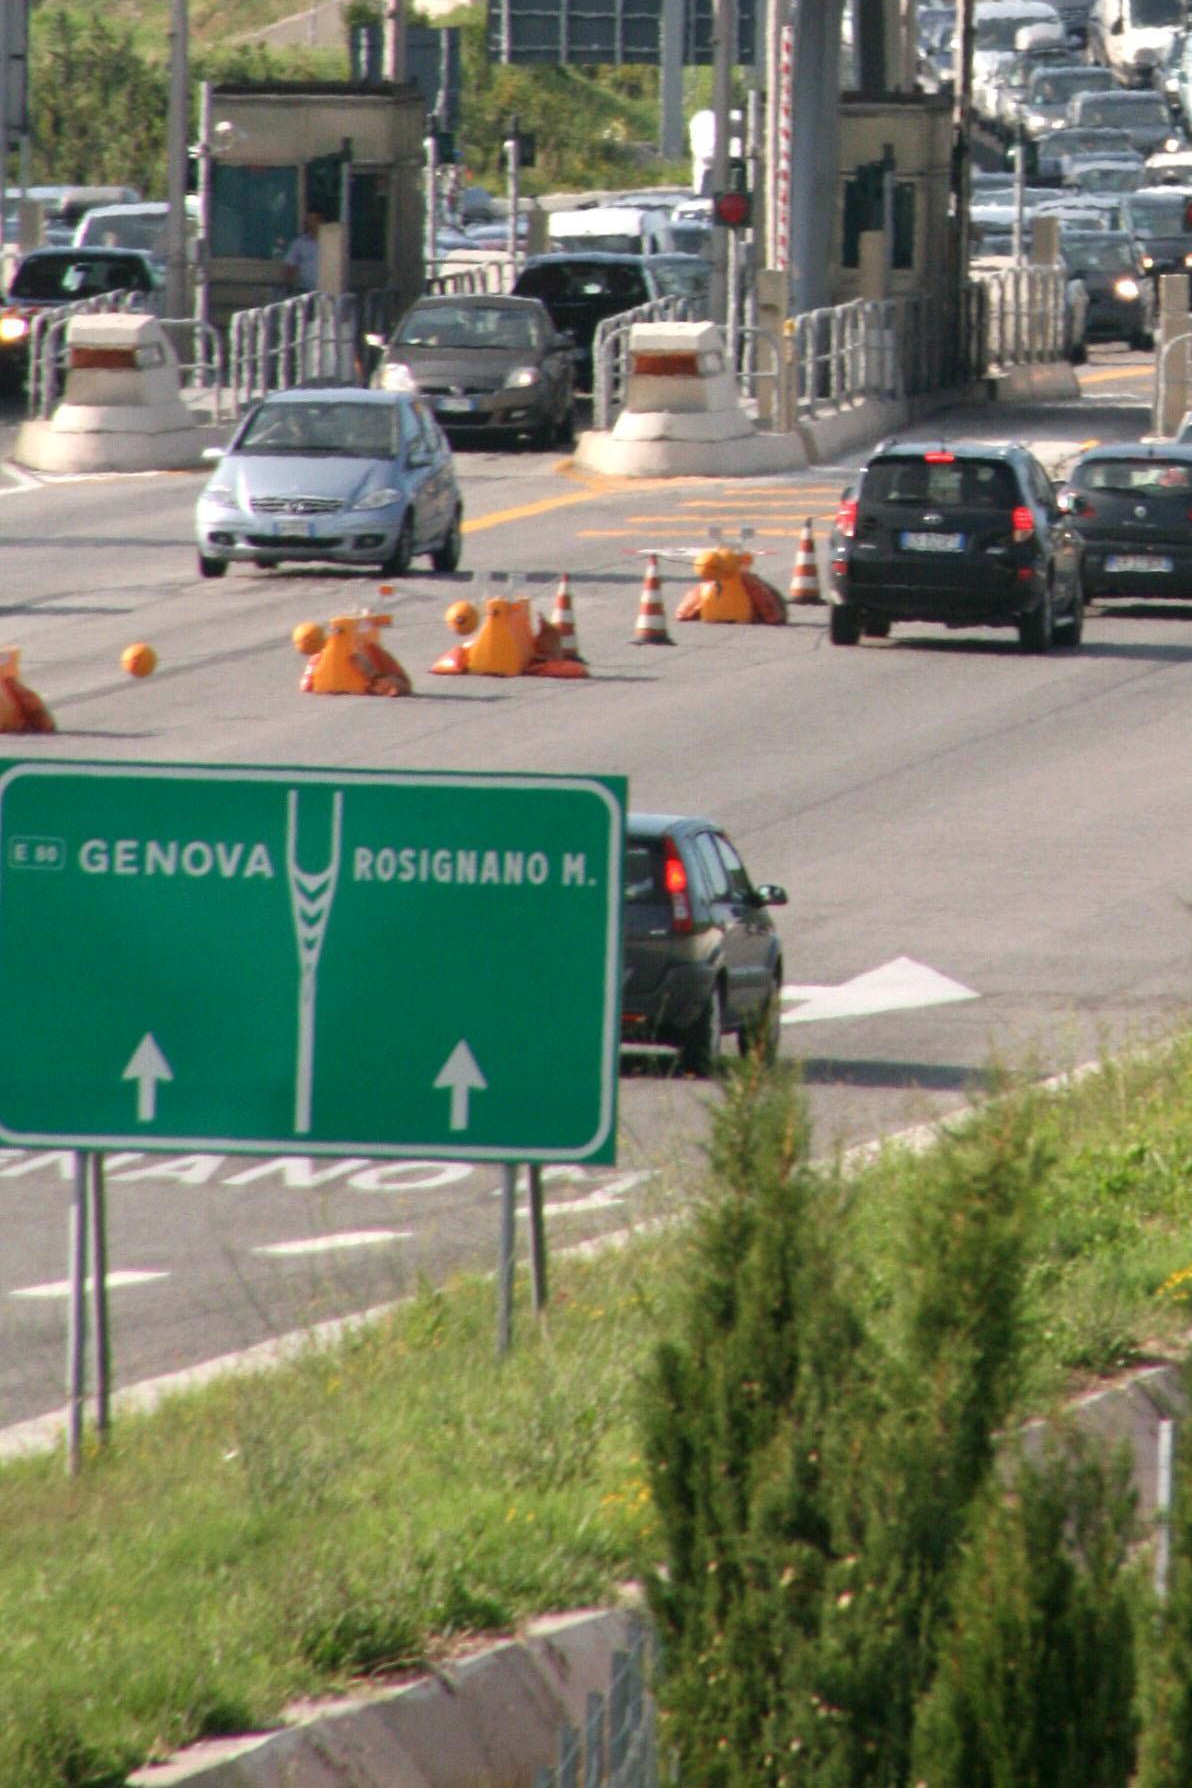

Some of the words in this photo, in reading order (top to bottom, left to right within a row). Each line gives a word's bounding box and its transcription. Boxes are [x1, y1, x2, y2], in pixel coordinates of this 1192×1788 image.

[14, 843, 28, 861] E
[79, 838, 275, 879] GENOVA
[353, 846, 549, 886] ROSIGNANO
[561, 851, 597, 887] M.
